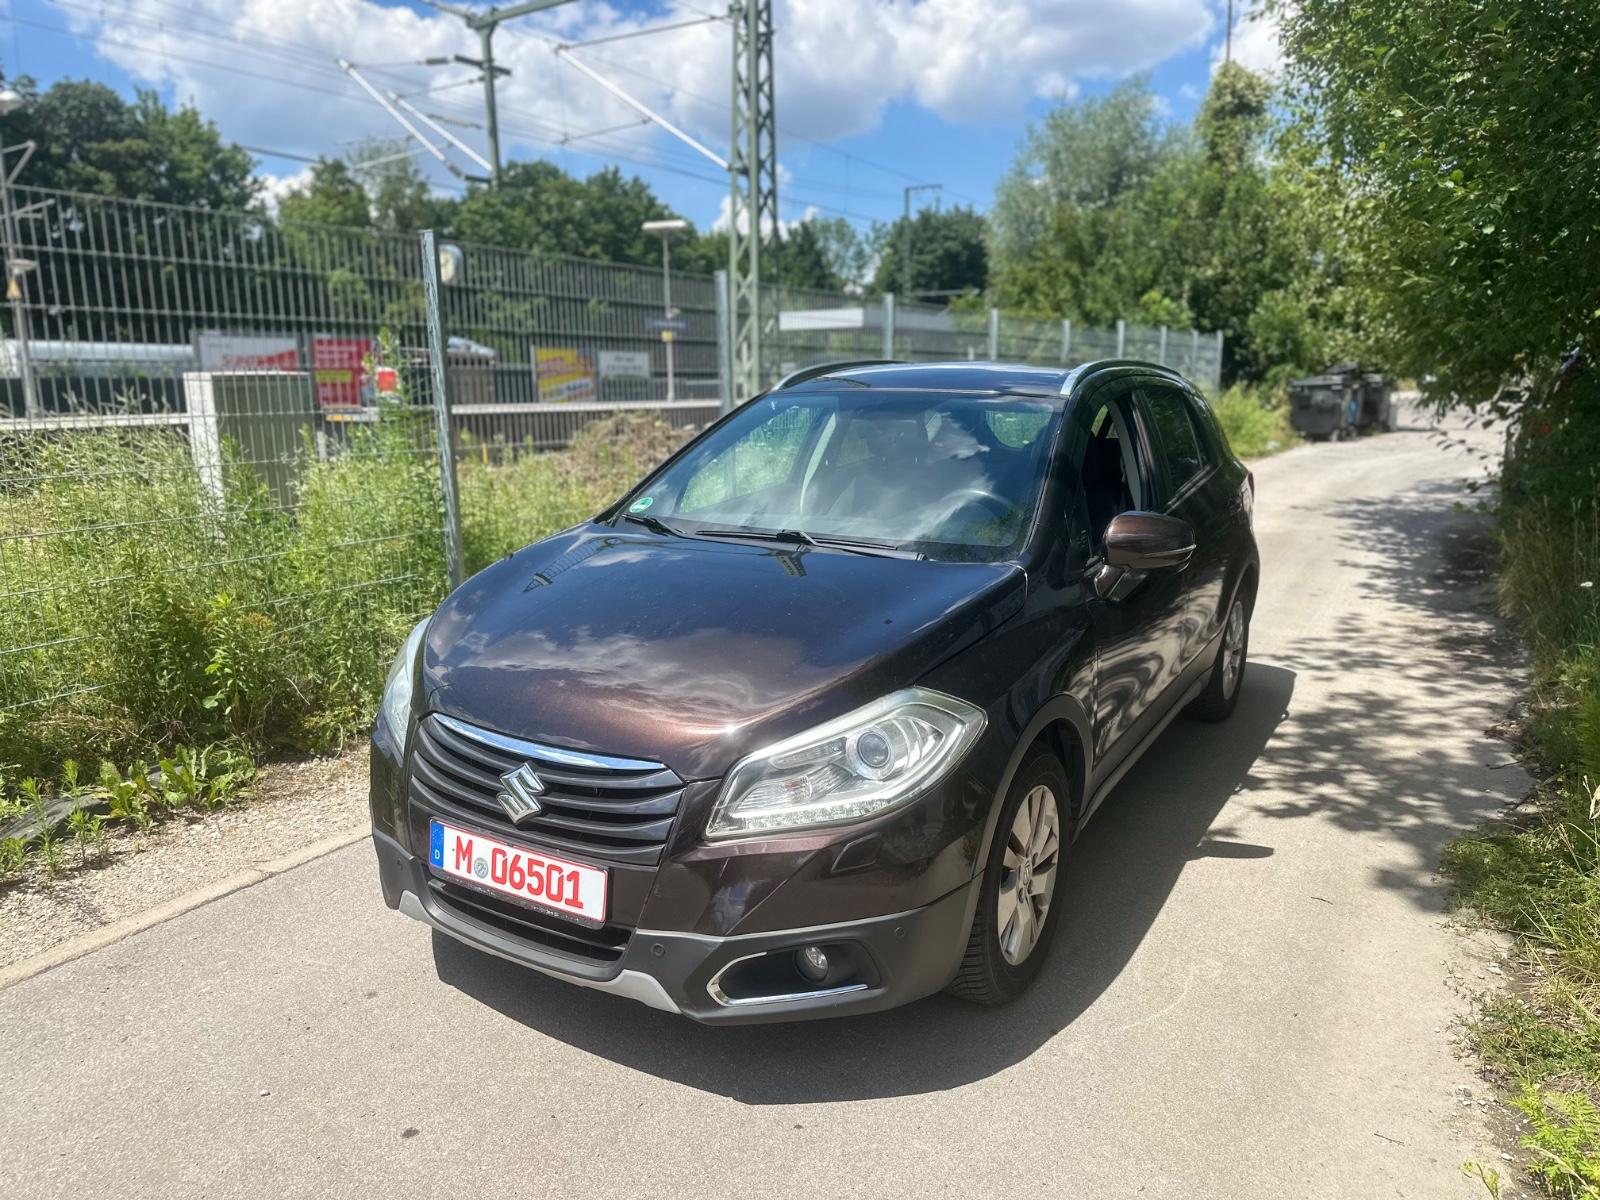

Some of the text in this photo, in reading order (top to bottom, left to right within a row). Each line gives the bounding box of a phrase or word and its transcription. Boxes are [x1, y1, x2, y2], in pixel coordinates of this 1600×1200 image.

[434, 850, 440, 860] D
[455, 835, 584, 909] M 06501
